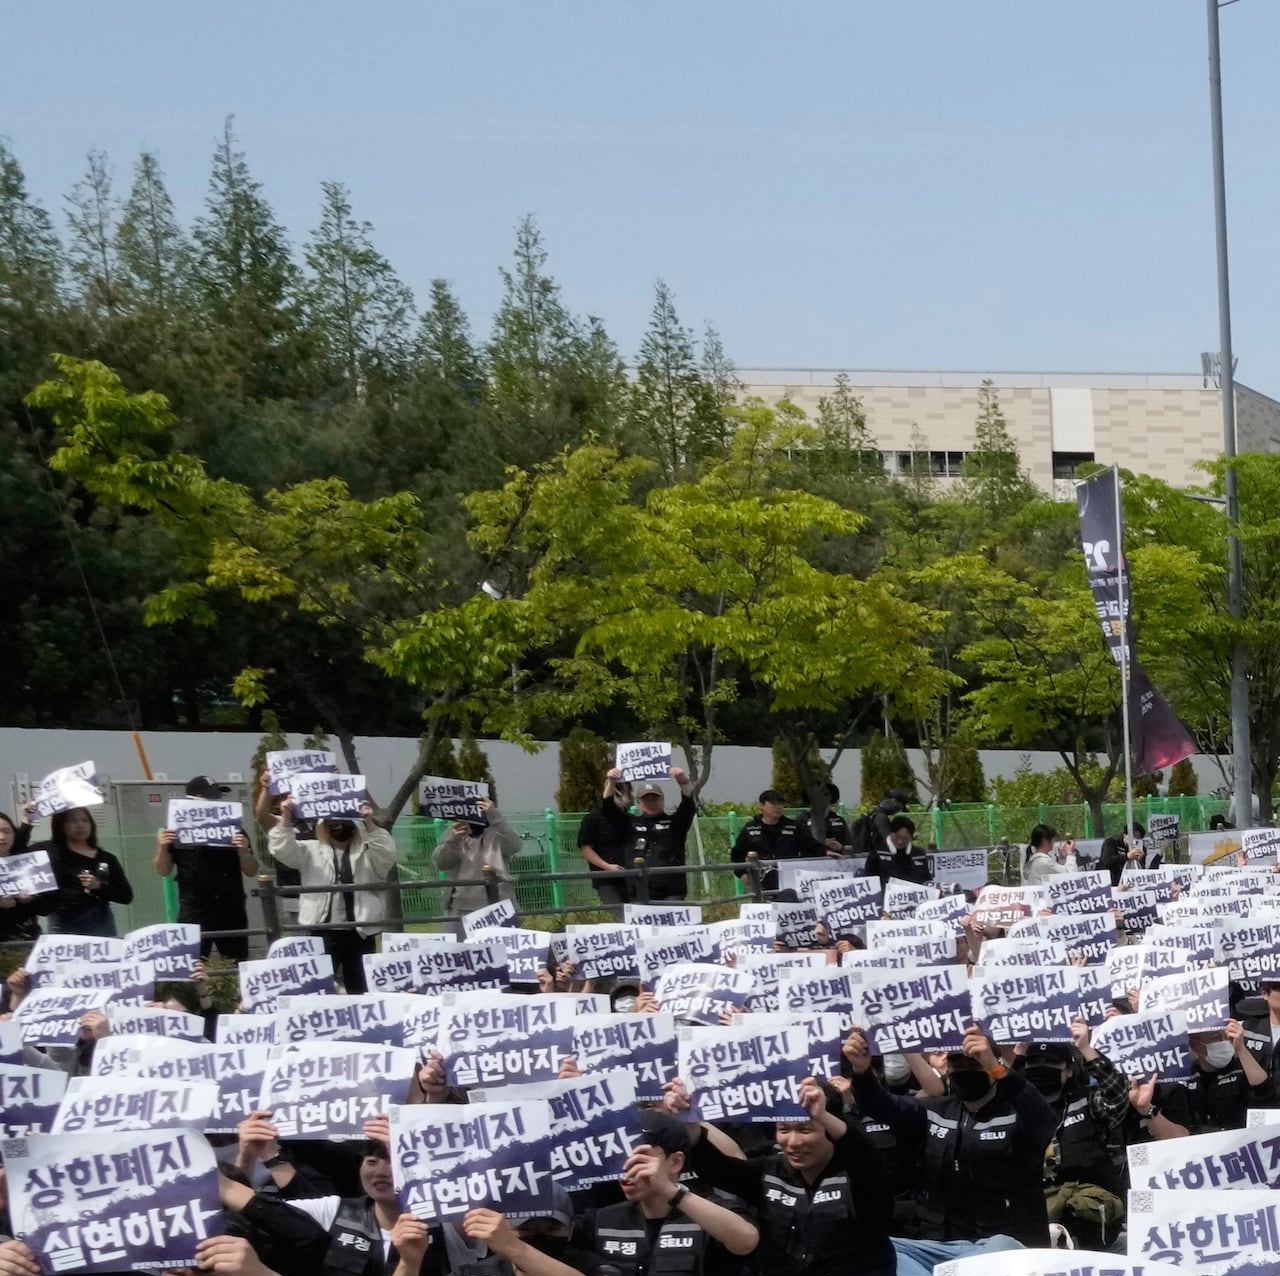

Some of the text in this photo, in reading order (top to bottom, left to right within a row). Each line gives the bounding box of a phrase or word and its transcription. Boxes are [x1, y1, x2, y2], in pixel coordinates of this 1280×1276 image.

[620, 746, 663, 763] 상한폐지
[296, 775, 359, 798] 상한폐지
[174, 806, 233, 823] 상한폐지
[177, 825, 241, 843] 실현하자
[819, 880, 871, 902] 상한폐지
[37, 941, 109, 964] 상한폐지
[124, 928, 187, 959] 상한폐지
[572, 928, 640, 953] 상한폐지
[245, 960, 319, 996] 상한폐지
[862, 971, 952, 1015] 상한폐지
[980, 970, 1066, 1004] 상한폐지
[286, 1000, 387, 1040] 상한폐지
[448, 1001, 558, 1041] 상한폐지
[874, 1011, 967, 1053] 실현하자
[989, 1006, 1079, 1039] 실현하자
[271, 1051, 392, 1093] 상한폐지
[453, 1044, 571, 1085] 실현하자
[686, 1033, 791, 1078] 상한폐지
[63, 1084, 192, 1131] 상한폐지
[272, 1094, 391, 1137] 실현하자
[698, 1076, 801, 1121] 실현하자
[396, 1111, 525, 1168] 상한폐지
[980, 1128, 1006, 1140] SELU
[26, 1135, 191, 1209] 상한폐지
[405, 1162, 552, 1219] 실현하자
[766, 1189, 797, 1207] 투쟁
[813, 1189, 841, 1204] SELU
[43, 1199, 223, 1272] 실현하자
[338, 1232, 371, 1252] 투쟁
[604, 1240, 637, 1255] 투쟁
[660, 1235, 693, 1248] SELU
